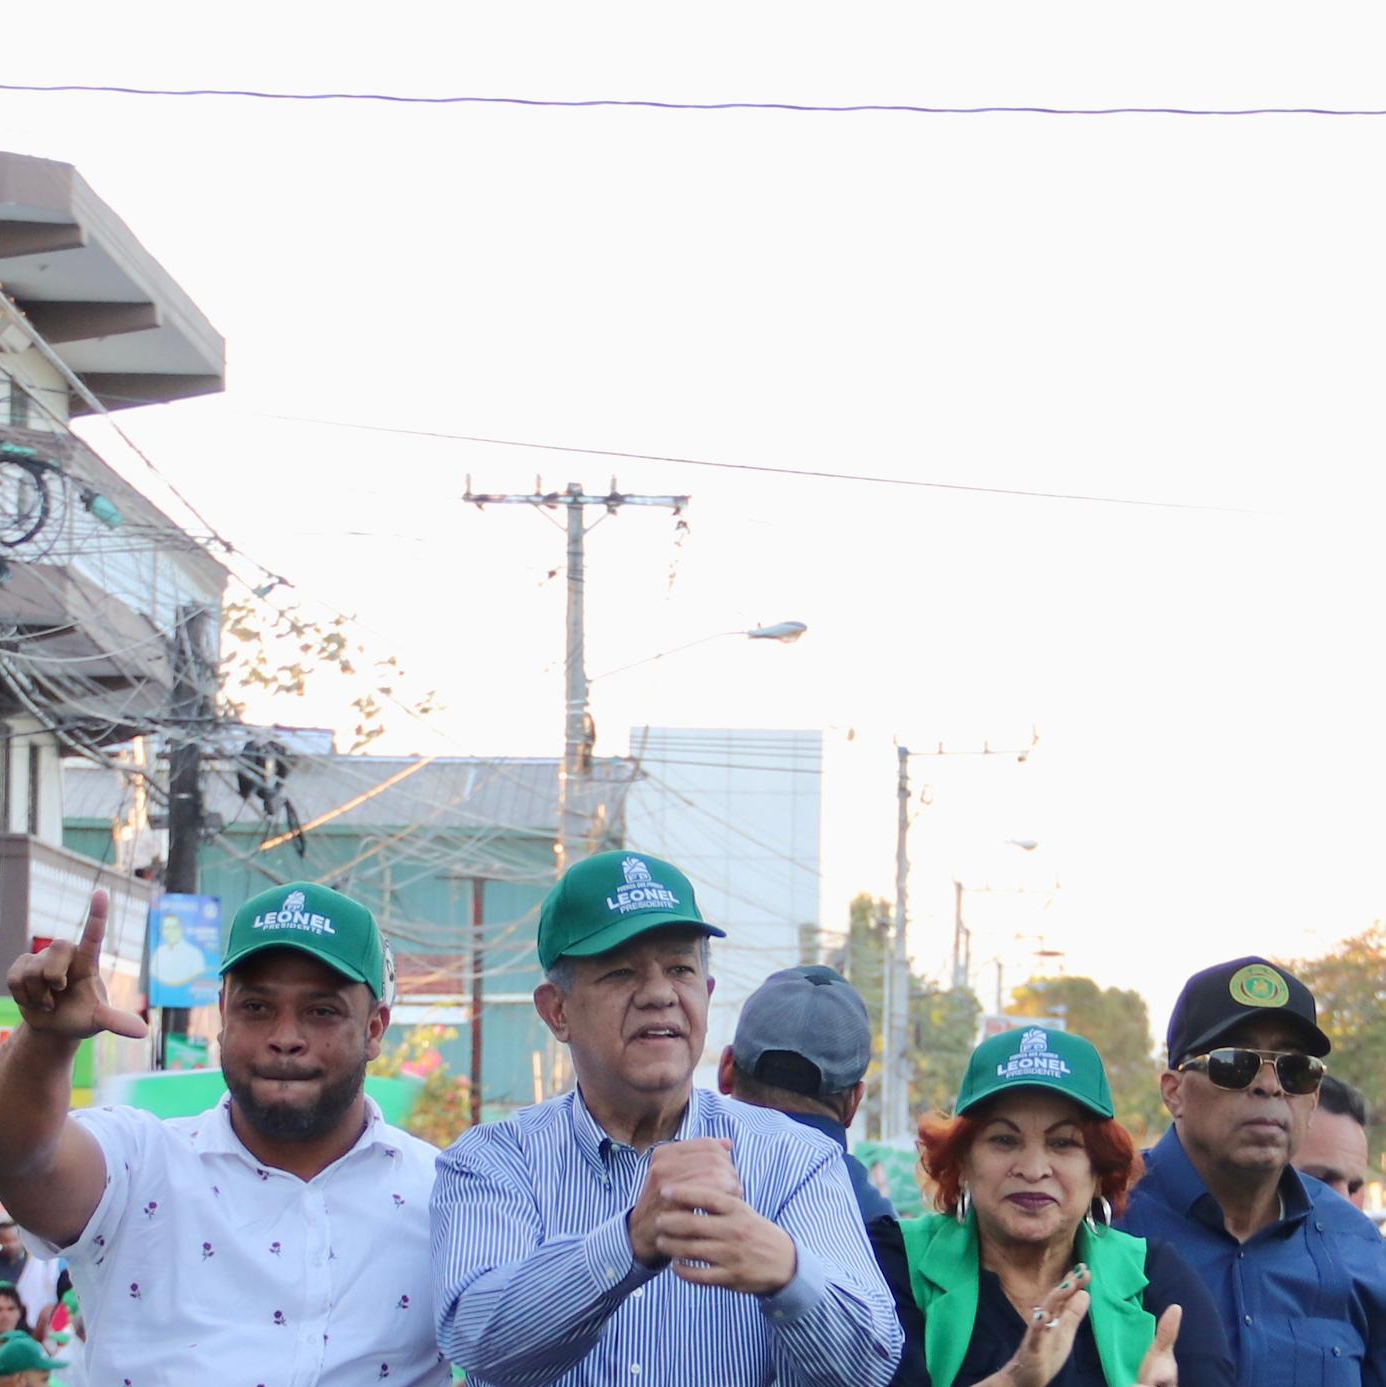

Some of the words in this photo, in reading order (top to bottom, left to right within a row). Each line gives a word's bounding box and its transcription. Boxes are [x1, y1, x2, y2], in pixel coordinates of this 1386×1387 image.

[606, 888, 681, 911] LEONEL
[618, 901, 675, 915] PRESIDENTE
[252, 911, 336, 935] LEONEL
[262, 922, 323, 935] PRESIDENTE
[996, 1057, 1072, 1077] LEONEL
